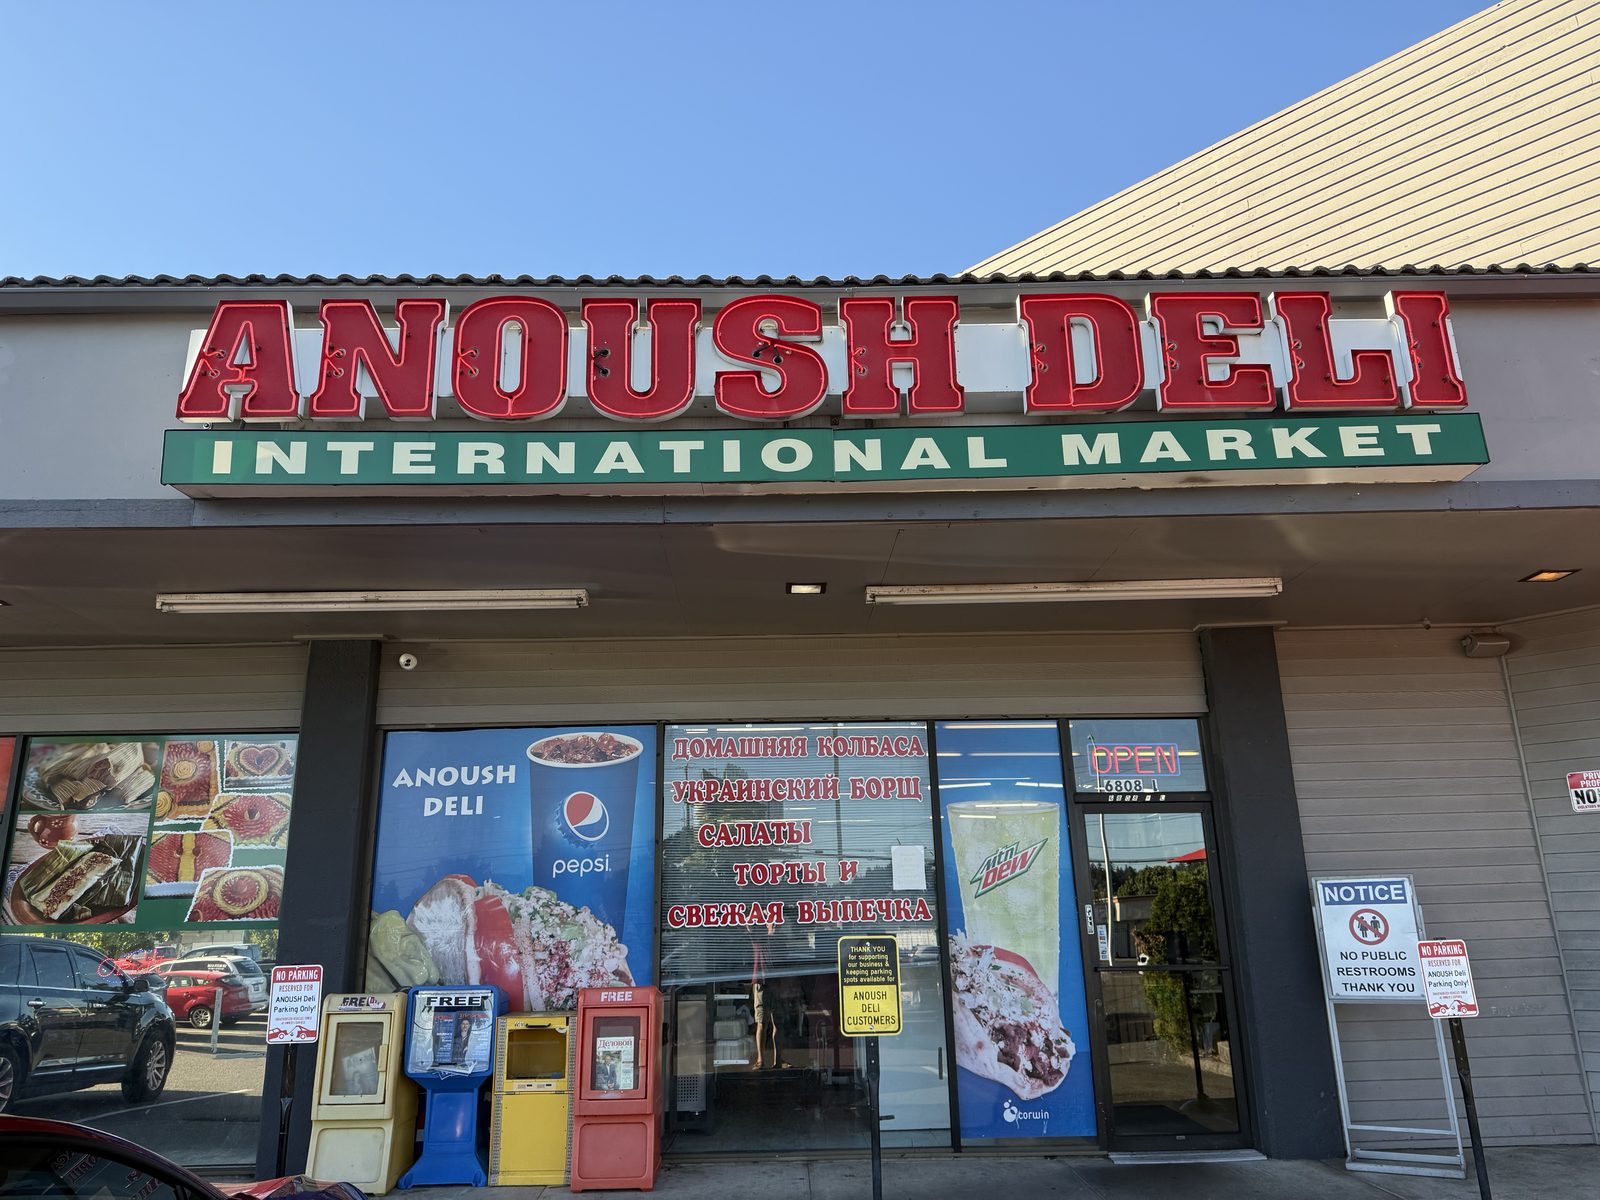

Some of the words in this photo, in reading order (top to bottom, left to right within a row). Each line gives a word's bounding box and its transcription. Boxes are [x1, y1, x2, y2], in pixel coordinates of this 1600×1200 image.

[178, 294, 965, 421] ANOUSH
[1017, 289, 1469, 415] DELI
[212, 436, 1007, 476] INTERNATIONAL
[1061, 423, 1444, 467] MARKET
[672, 736, 808, 761] ДОМАШНЯЯ
[816, 735, 925, 758] КОЛБАСА
[1091, 746, 1177, 774] OPEN
[392, 764, 516, 788] ANOUSH
[672, 773, 840, 804] УКРАИНСКИЙ
[849, 776, 923, 802] БОРЩ
[1104, 780, 1143, 792] 6808
[1574, 789, 1598, 805] NO
[423, 796, 484, 817] DELI
[698, 820, 812, 847] САЛАТЫ
[552, 854, 610, 879] pepsi
[733, 861, 826, 886] ТОРТЫ
[838, 860, 859, 883] И
[1324, 884, 1405, 902] NOTICE
[667, 901, 785, 928] СВЕЖАЯ
[797, 898, 933, 924] ВЫПЕЧКА
[1421, 946, 1432, 956] NO
[1433, 944, 1462, 956] PARKING
[858, 953, 889, 961] supporting
[1340, 951, 1357, 961] NO
[1361, 951, 1407, 961] PUBLIC
[1428, 959, 1451, 967] RESERVED
[276, 971, 286, 980] NO
[288, 969, 318, 980] PARKING
[870, 968, 892, 976] parking
[1337, 967, 1416, 977] RESTROOMS
[1428, 970, 1453, 978] ANOUSH
[1454, 969, 1466, 977] Deli
[279, 984, 303, 992] RESERVED
[1342, 982, 1385, 992] THANK
[1386, 982, 1415, 992] YOU
[1428, 981, 1453, 989] Parking
[275, 995, 302, 1003] ANOUSH
[342, 996, 370, 1007] FRE
[426, 996, 481, 1006] FREE
[600, 991, 633, 1002] FREE
[853, 991, 887, 1001] ANOUSH
[273, 1006, 299, 1014] Parking
[861, 1003, 881, 1013] DELI
[847, 1015, 896, 1026] CUSTOMERS
[597, 1038, 633, 1049] Деловой
[1018, 1109, 1050, 1120] corwin
